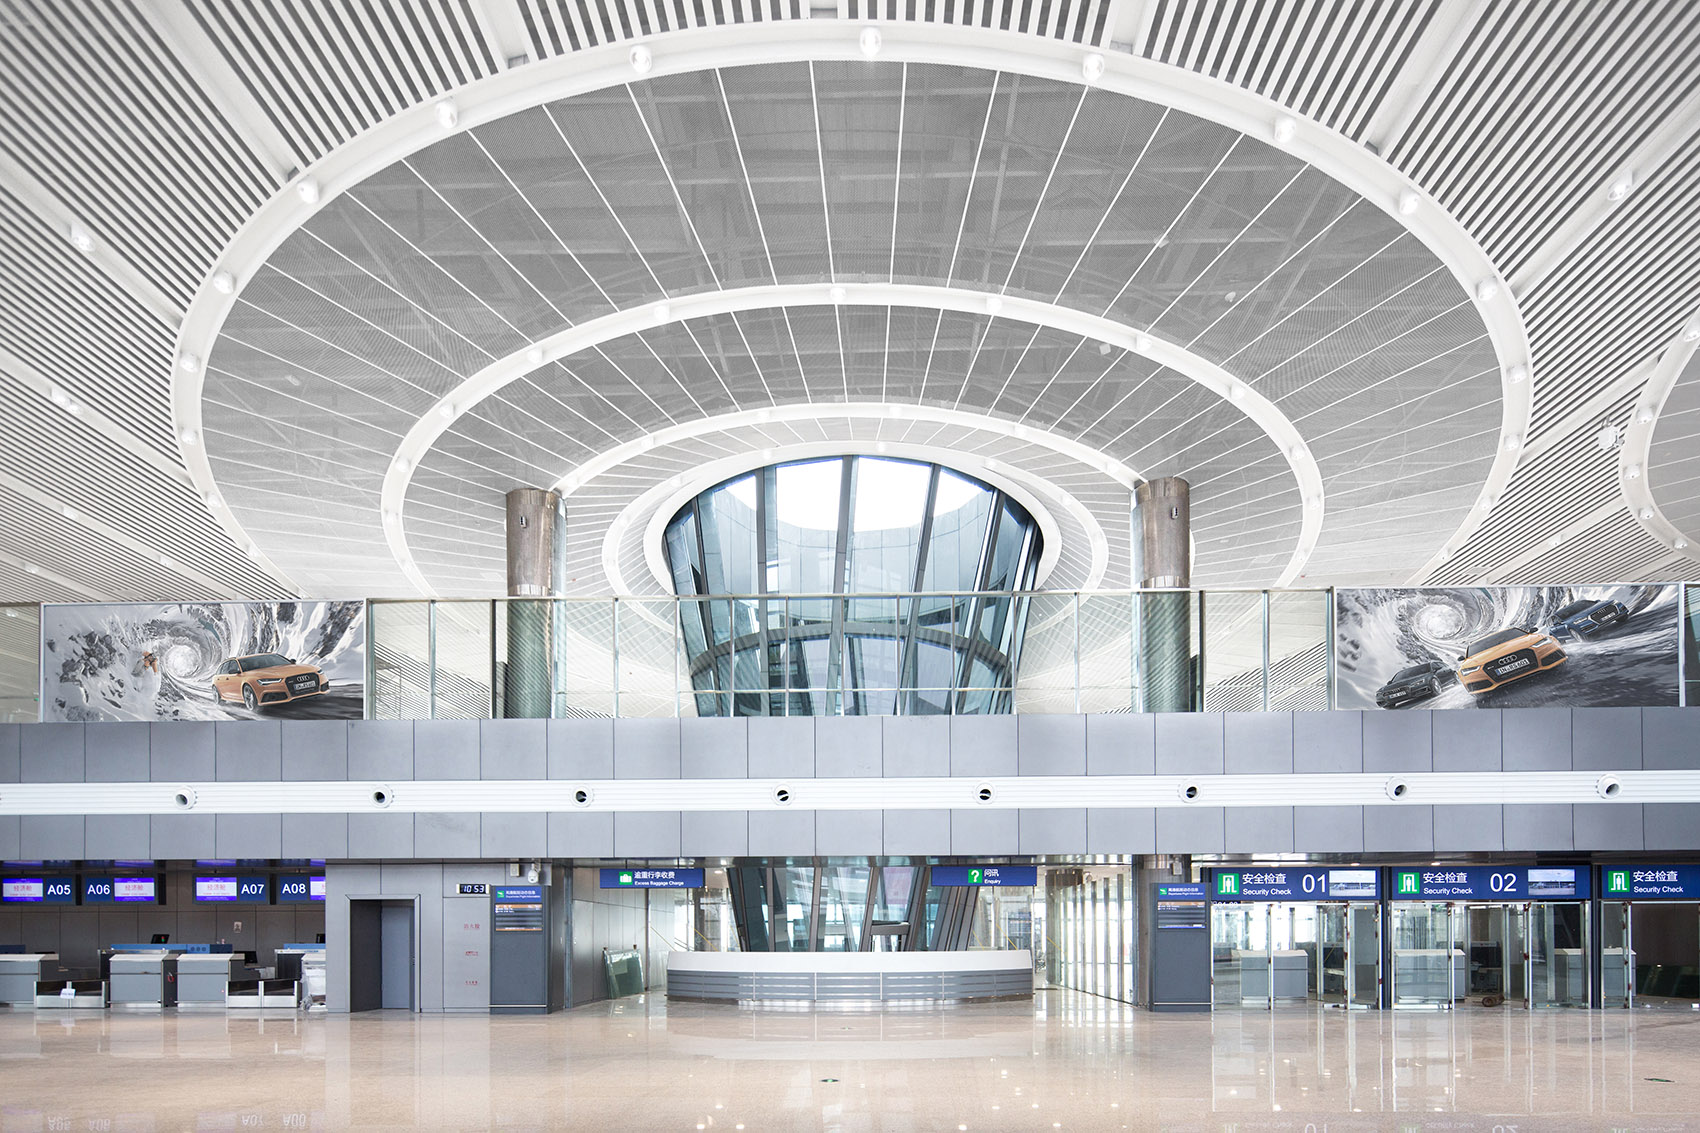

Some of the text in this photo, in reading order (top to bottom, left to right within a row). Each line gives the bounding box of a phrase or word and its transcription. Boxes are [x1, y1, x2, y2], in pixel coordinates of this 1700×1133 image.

[1242, 873, 1286, 884] 安全检查
[1423, 872, 1468, 884] 安全检查
[1633, 871, 1678, 882] 安全检查
[1302, 874, 1326, 893] 01
[1490, 873, 1517, 892] 02
[48, 884, 71, 895] A05
[88, 884, 111, 895] A06
[241, 884, 264, 894] A07
[282, 884, 306, 894] A08
[1242, 888, 1269, 896] Security
[1633, 886, 1660, 894] Security
